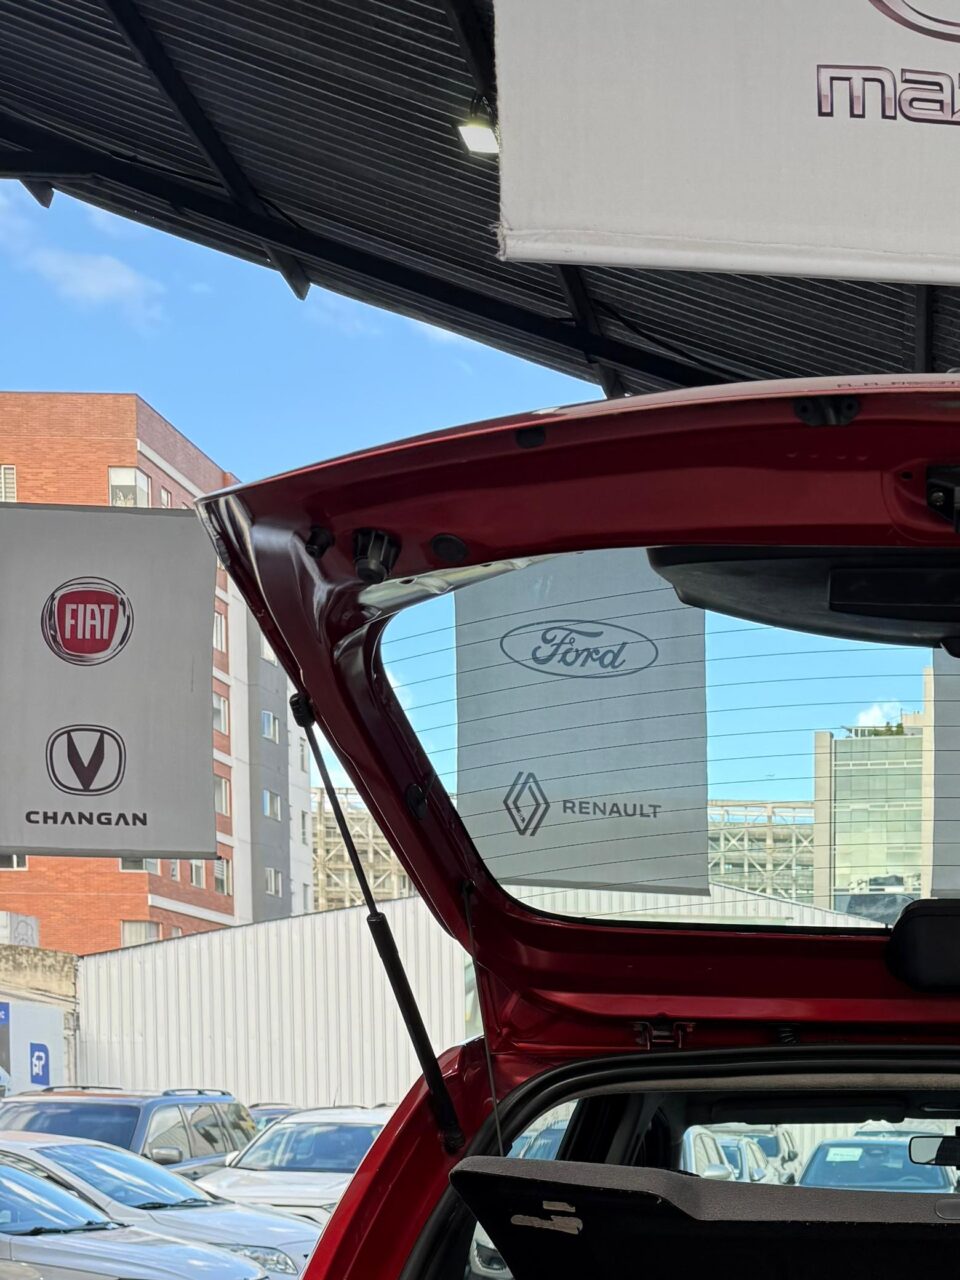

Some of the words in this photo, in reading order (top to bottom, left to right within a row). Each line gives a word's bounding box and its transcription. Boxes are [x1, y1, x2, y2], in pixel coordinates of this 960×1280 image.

[65, 603, 115, 640] FIAT
[531, 626, 630, 670] Ford
[25, 811, 148, 826] CHANGAN
[562, 799, 662, 819] RENAULT
